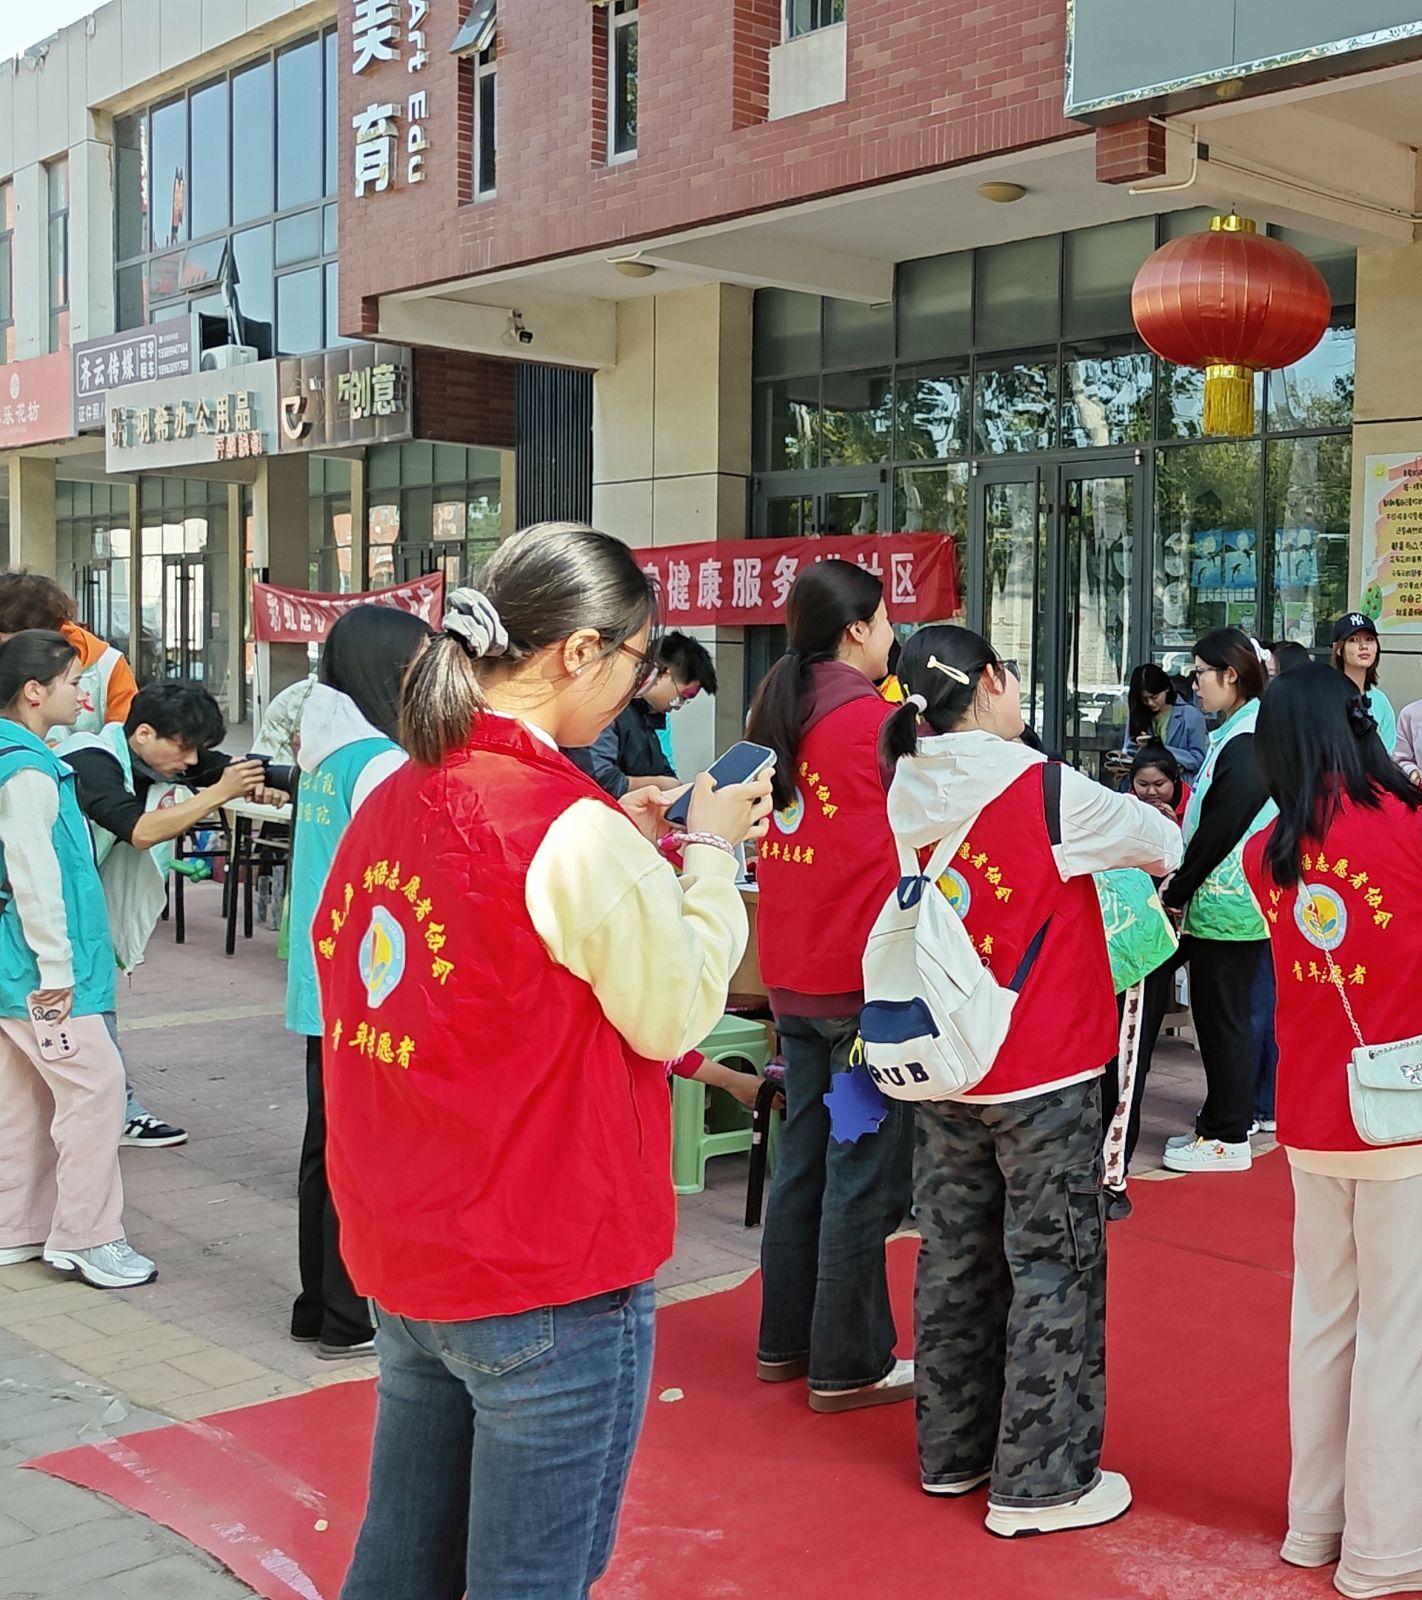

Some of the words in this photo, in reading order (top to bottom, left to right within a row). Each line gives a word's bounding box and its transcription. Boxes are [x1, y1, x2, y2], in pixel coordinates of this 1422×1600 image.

[80, 348, 135, 390] 齐云传媒
[643, 553, 917, 611] 健康服务区
